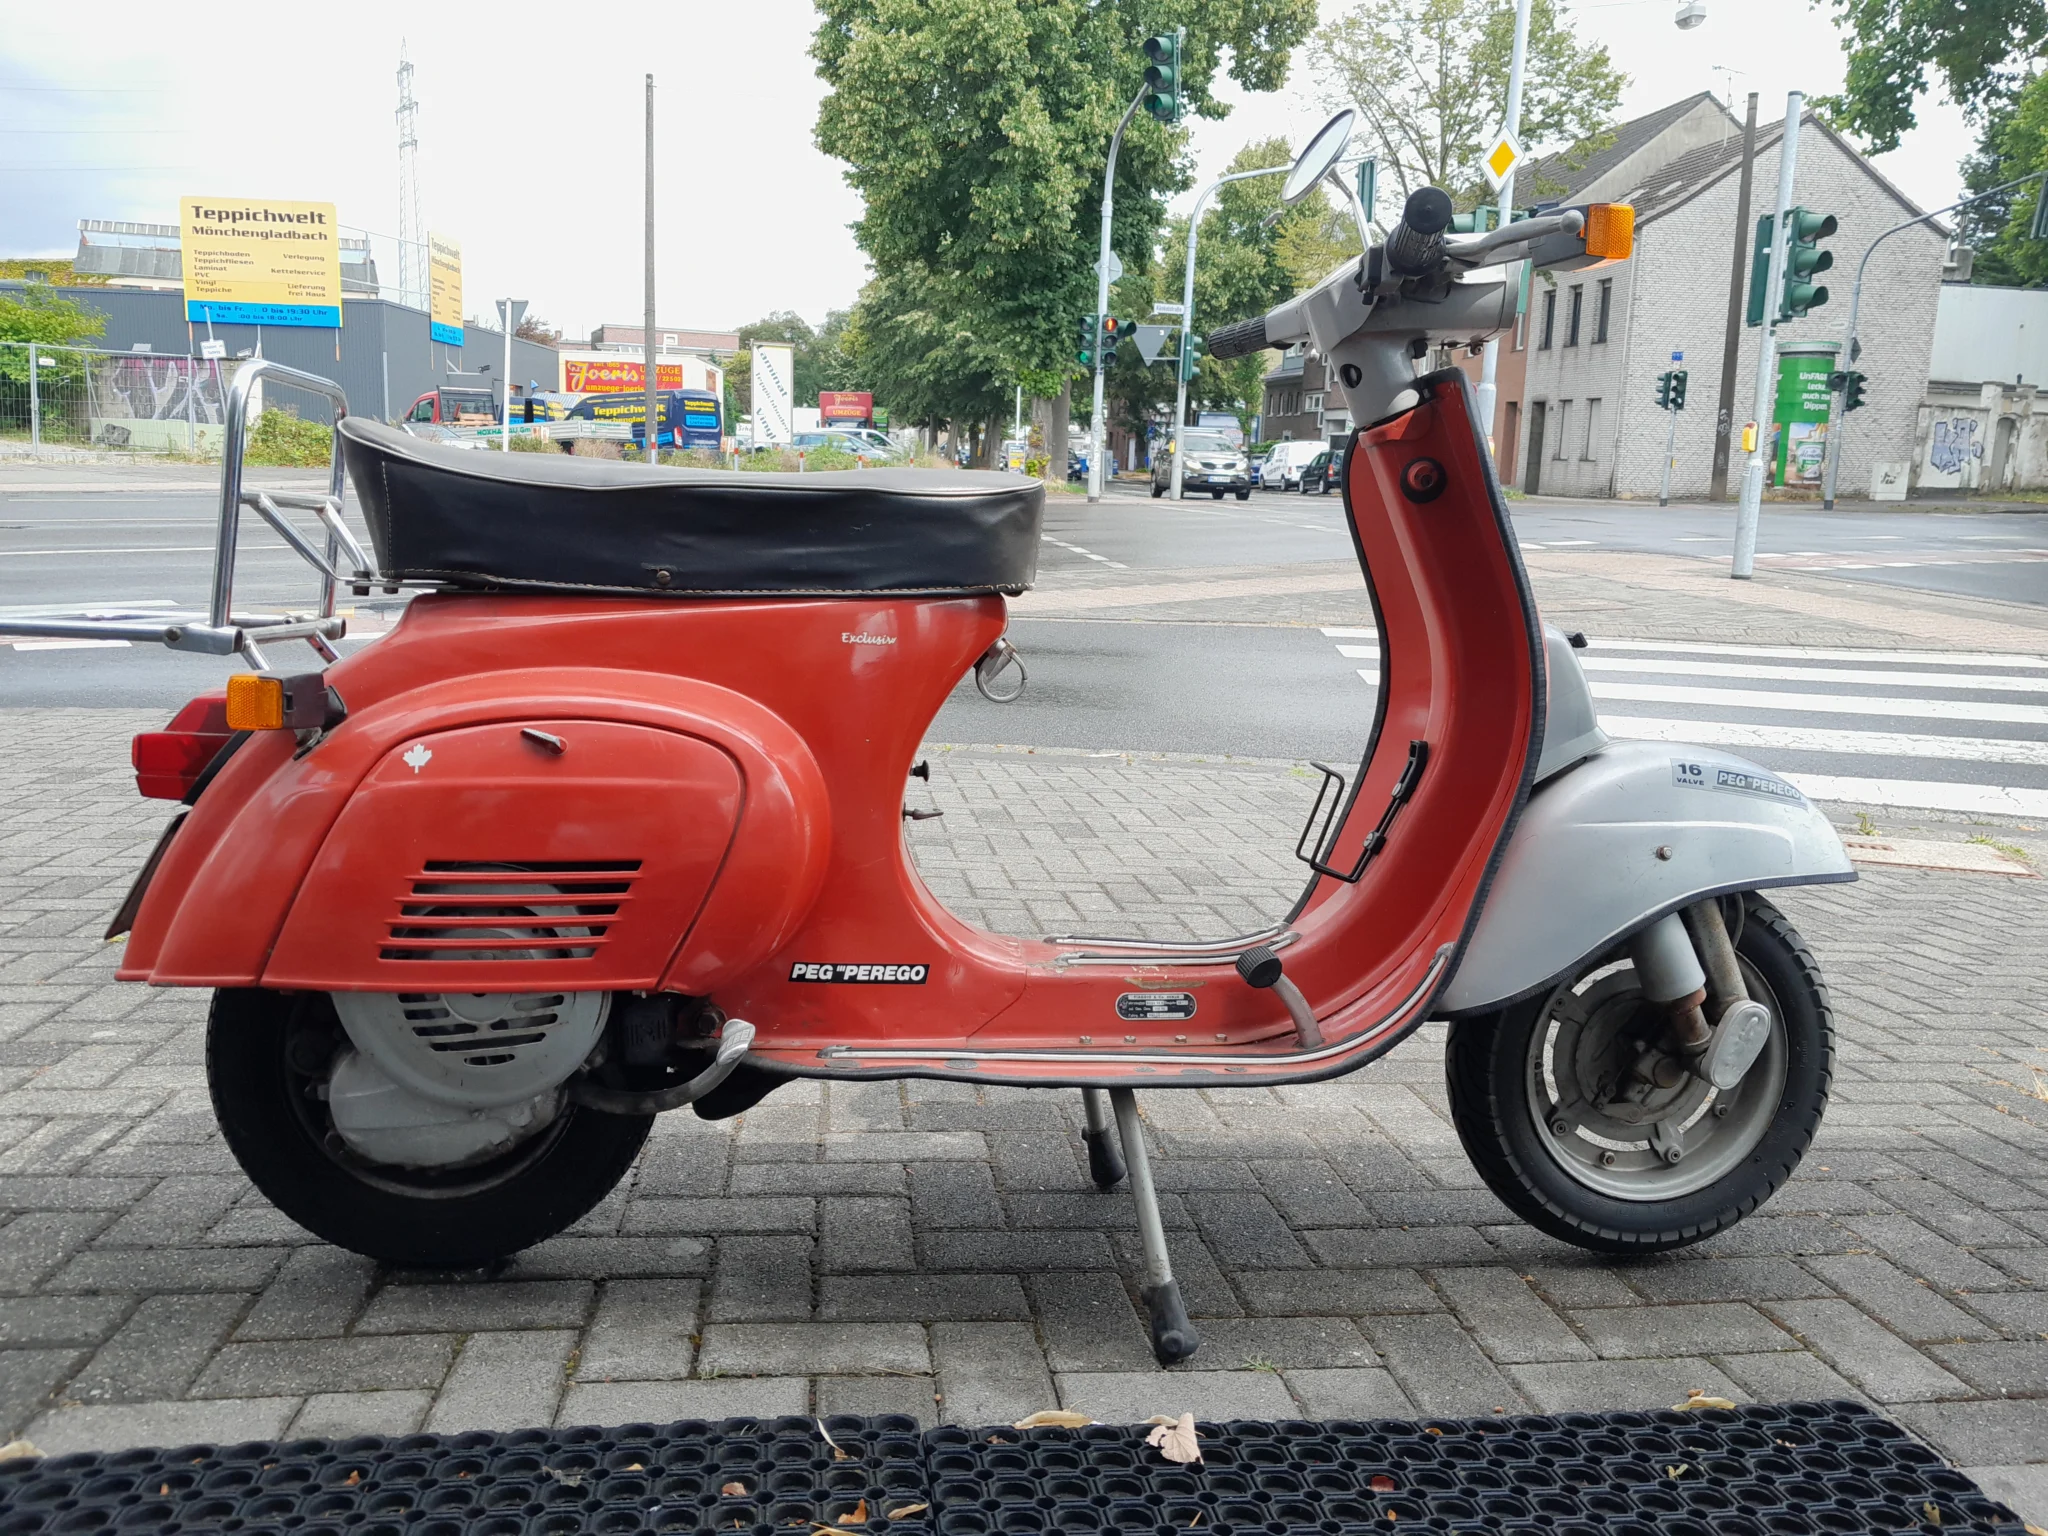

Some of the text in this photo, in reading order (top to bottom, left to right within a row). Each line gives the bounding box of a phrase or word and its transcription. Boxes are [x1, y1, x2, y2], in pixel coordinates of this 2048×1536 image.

[191, 205, 327, 225] Teppichwelt
[192, 225, 328, 241] Mönchengladbach
[193, 249, 251, 257] Teppichboden
[283, 253, 325, 261] Verlegung
[194, 257, 255, 265] Teppichfliesen
[271, 268, 326, 276] Kettelservice
[287, 283, 325, 291] Lieferung
[640, 364, 681, 375] UZÜGE
[567, 361, 639, 391] Joeris
[755, 372, 790, 434] Teppichboden
[593, 404, 666, 416] Teppichwlt
[756, 407, 777, 440] Vinyl
[1677, 763, 1703, 776] 16
[1676, 777, 1705, 786] VALVE
[1718, 773, 1800, 799] PEG PEREGO
[791, 963, 926, 982] PEG PEREGO
